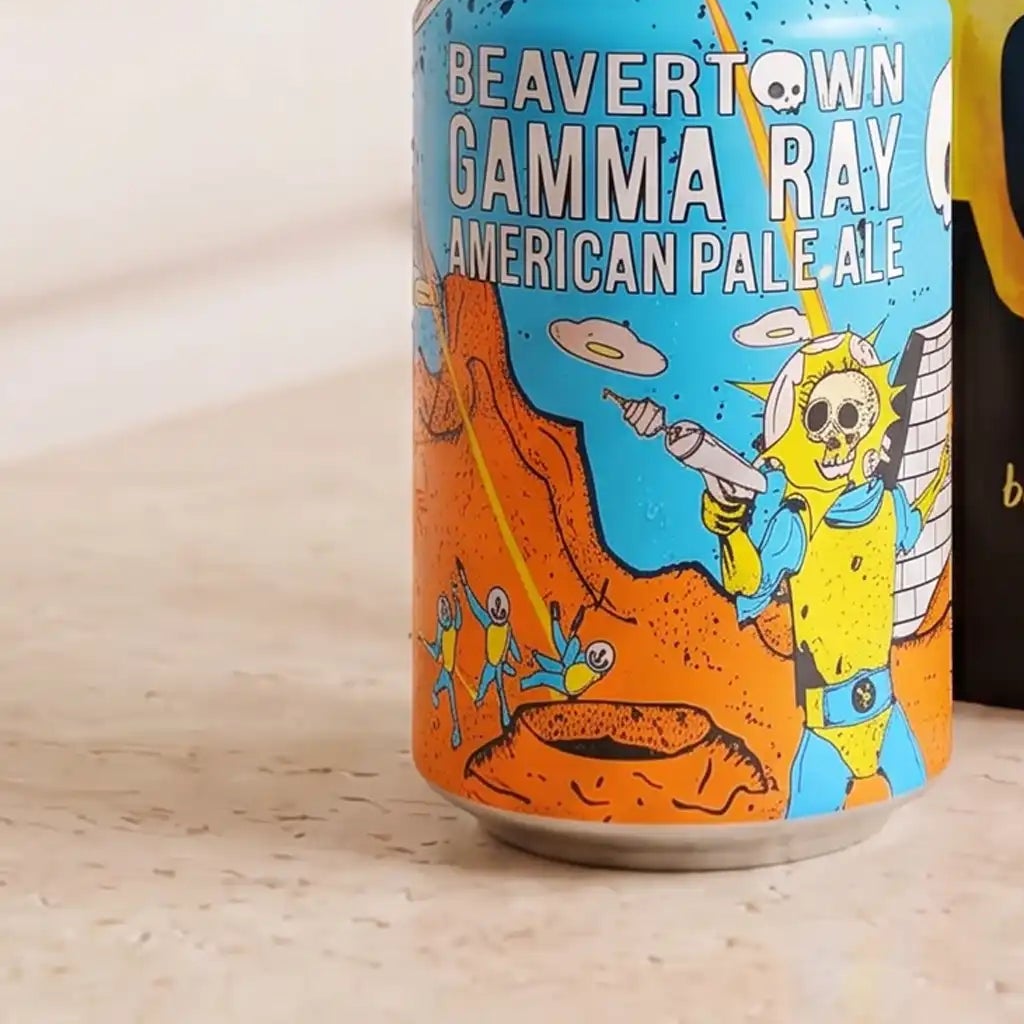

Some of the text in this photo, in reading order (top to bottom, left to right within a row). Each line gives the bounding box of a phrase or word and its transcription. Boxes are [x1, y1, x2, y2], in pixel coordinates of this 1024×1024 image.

[447, 111, 902, 223] GAMMA RAY
[446, 216, 905, 295] AMERICAN PALE ALE
